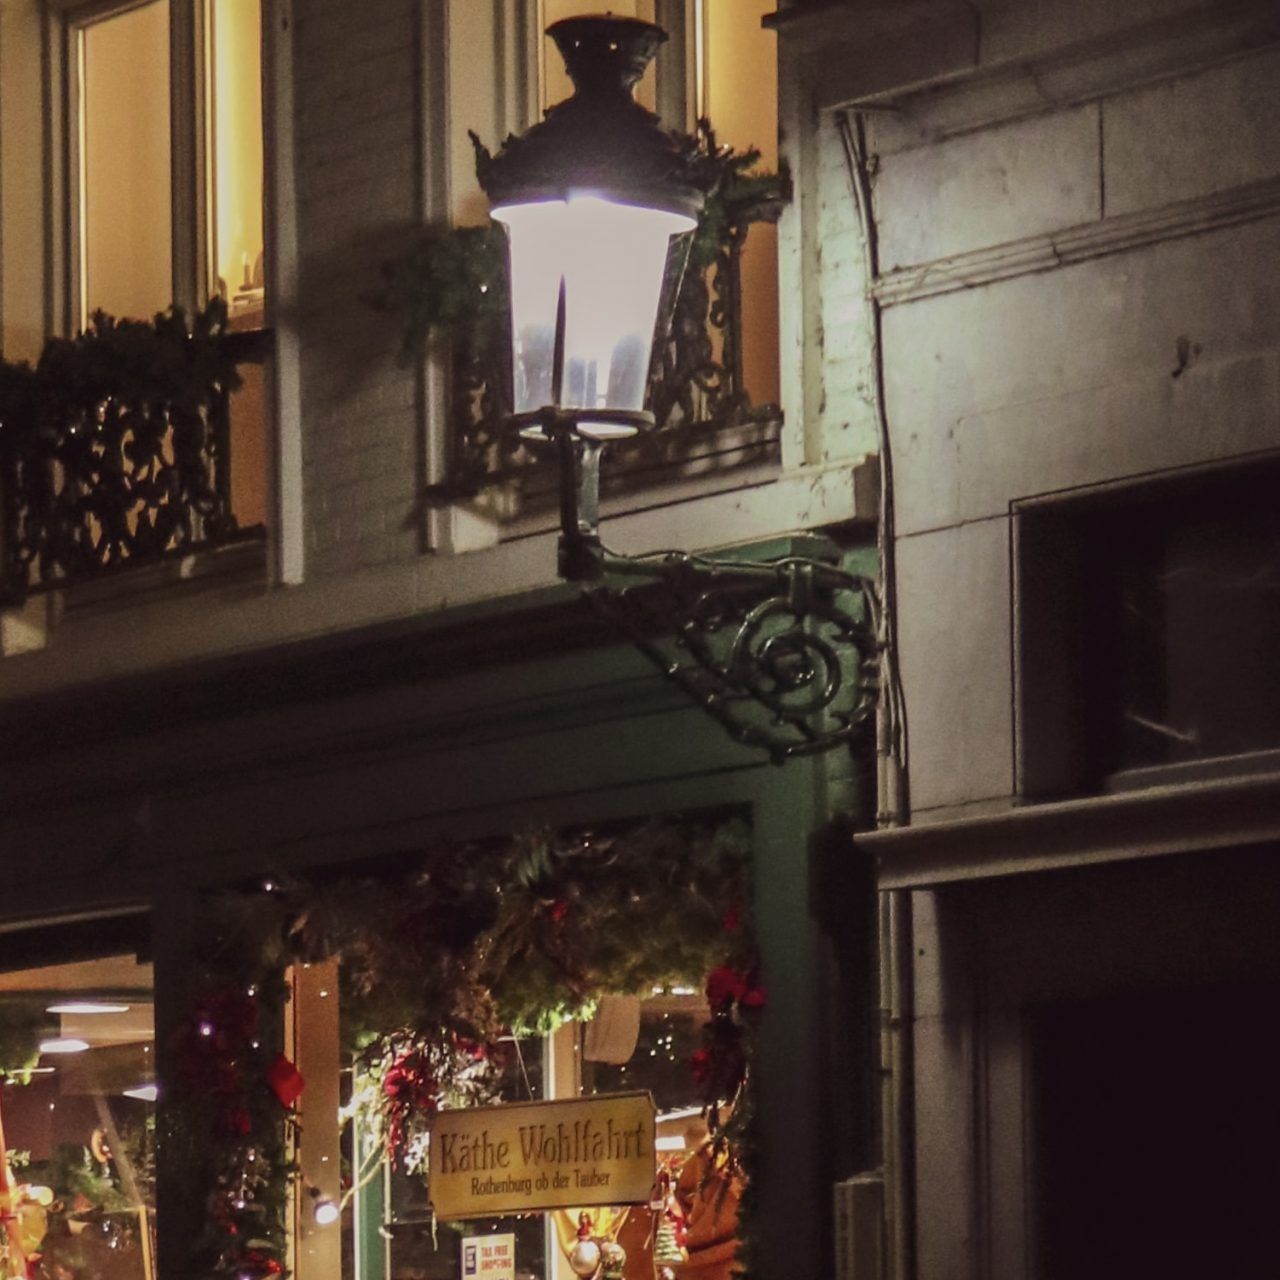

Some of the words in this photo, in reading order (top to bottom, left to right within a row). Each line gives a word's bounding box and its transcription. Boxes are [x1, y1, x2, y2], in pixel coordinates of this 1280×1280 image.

[440, 1130, 510, 1173] Käthe
[518, 1119, 646, 1166] Wohlfahrt
[471, 1176, 532, 1196] Rothenburg
[536, 1174, 549, 1191] ob
[552, 1172, 570, 1189] der
[574, 1169, 611, 1188] Tauber
